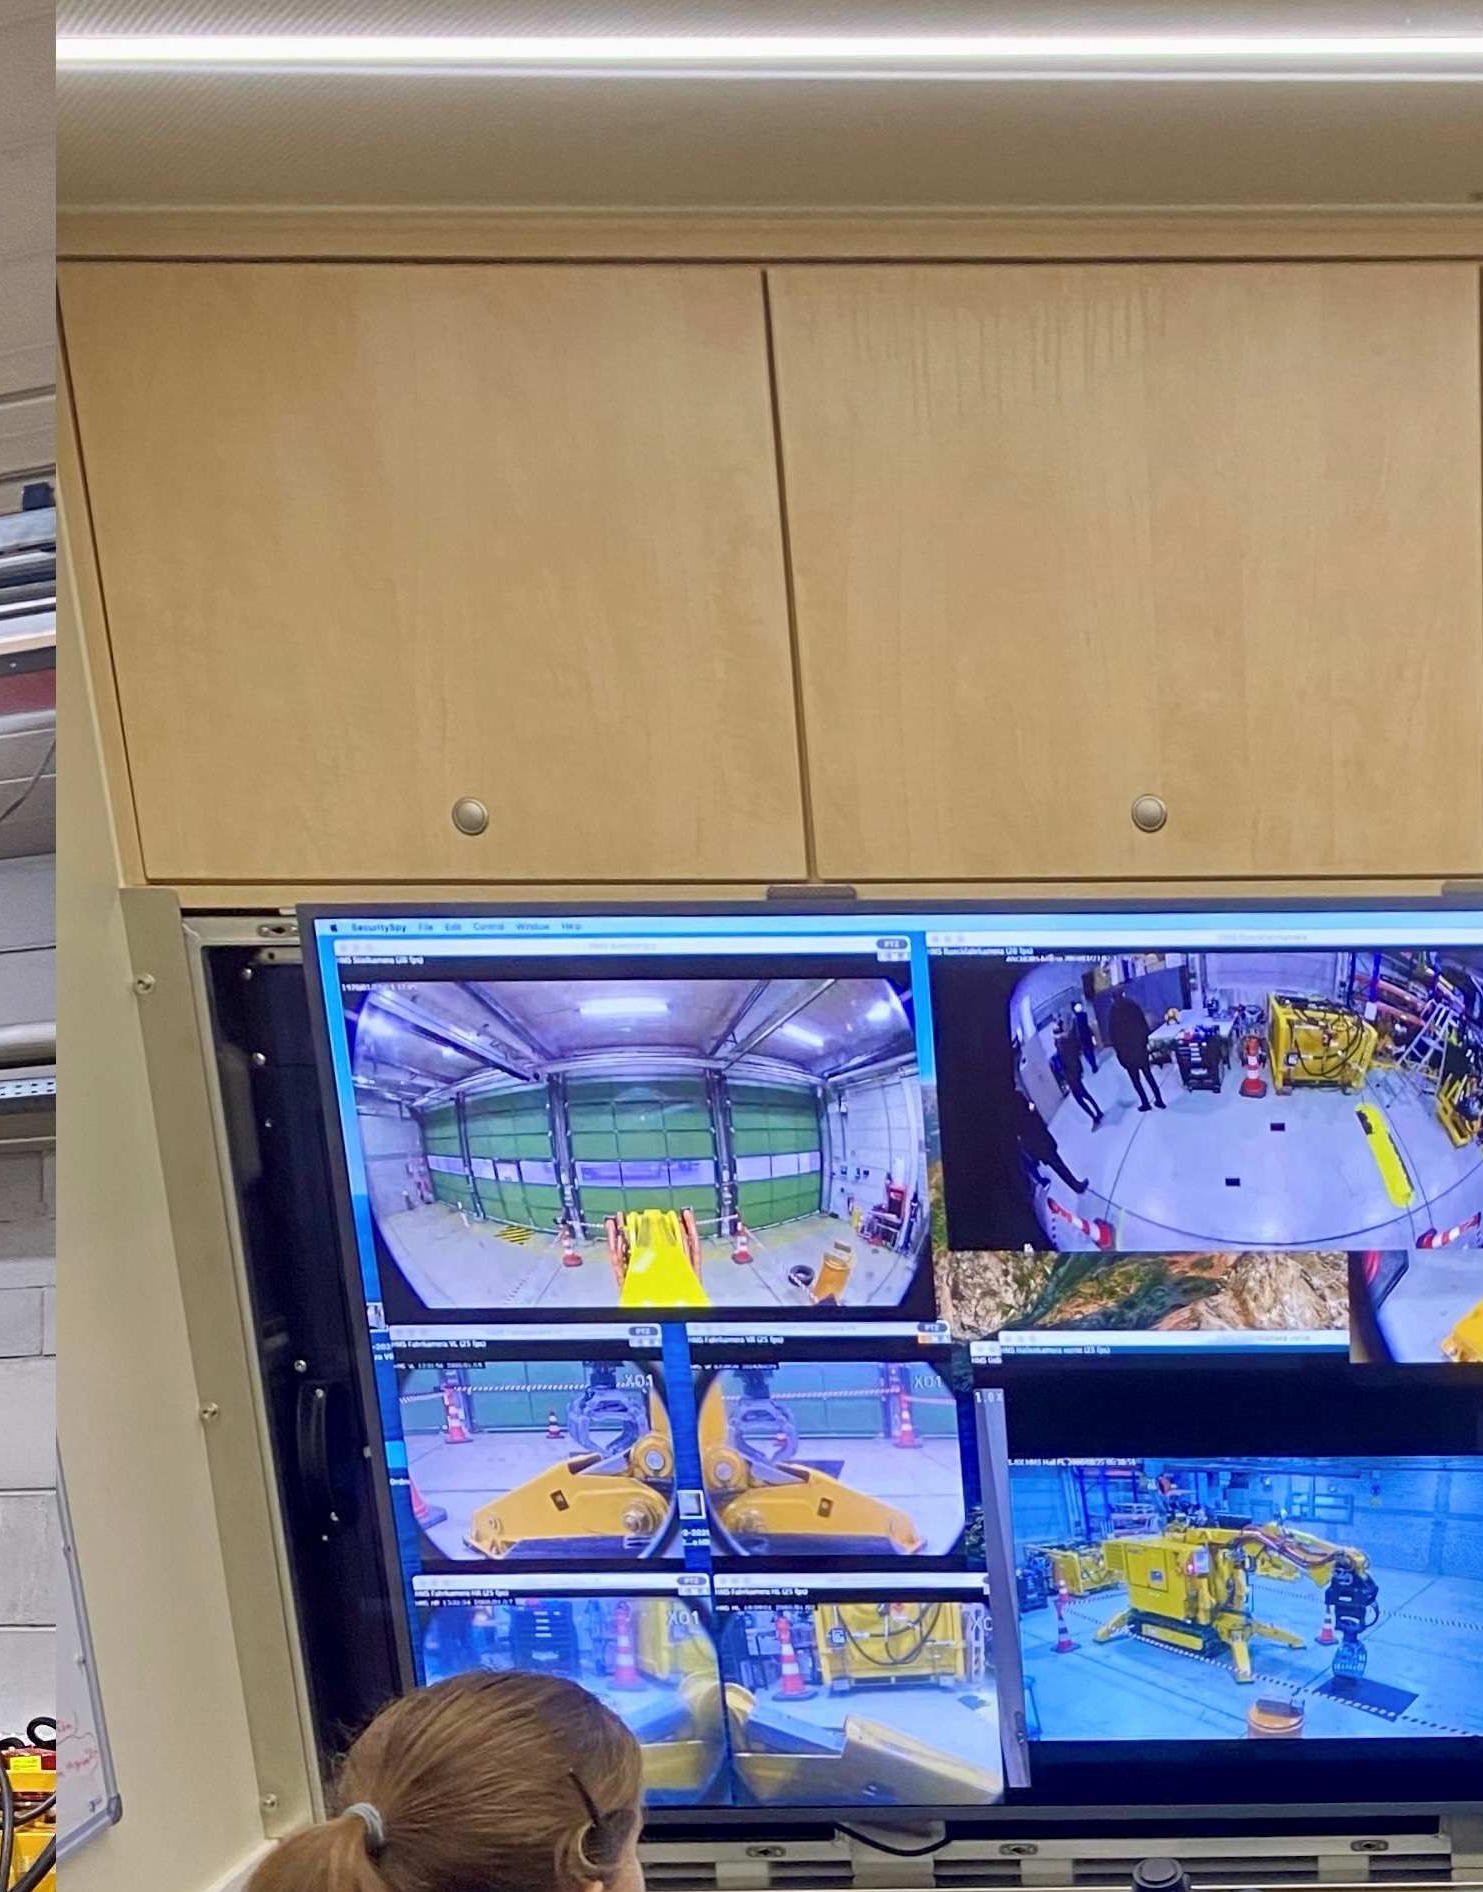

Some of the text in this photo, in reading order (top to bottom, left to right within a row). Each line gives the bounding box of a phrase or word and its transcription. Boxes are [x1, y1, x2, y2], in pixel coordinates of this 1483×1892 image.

[351, 922, 581, 933] SecuritySpy File Edit Control Window Help
